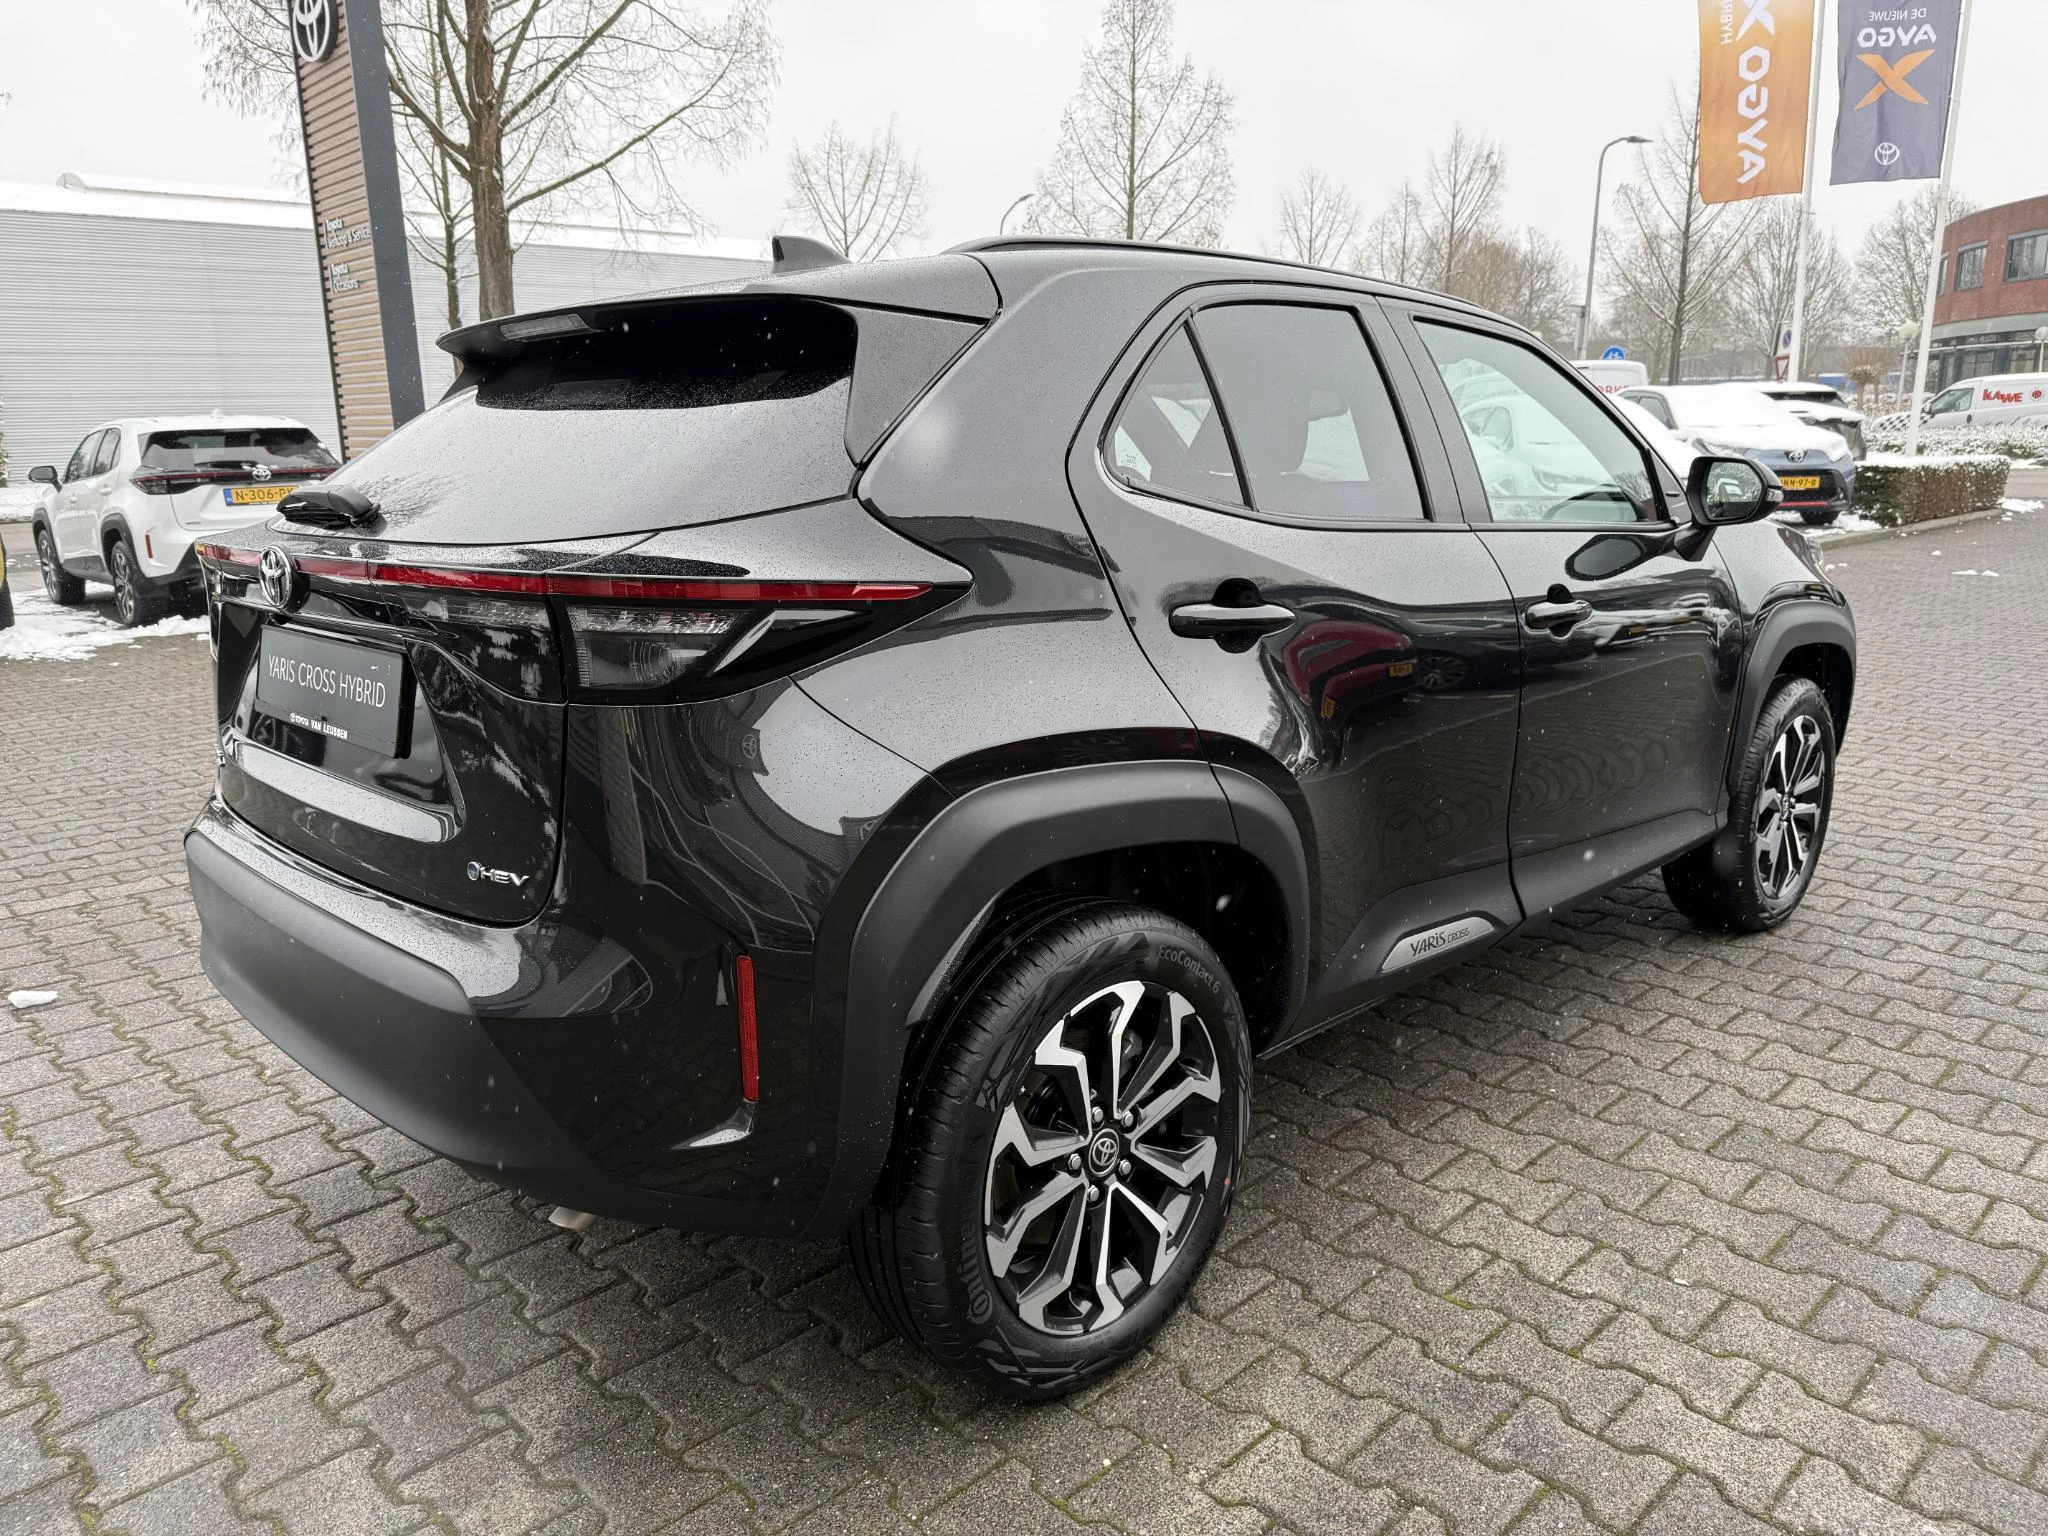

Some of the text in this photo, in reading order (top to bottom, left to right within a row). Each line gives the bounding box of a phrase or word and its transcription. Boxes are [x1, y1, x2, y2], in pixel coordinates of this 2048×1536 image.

[325, 218, 344, 233] Toyota
[331, 263, 349, 278] Toyota
[268, 654, 386, 708] YARIS CROSS HYBRID
[310, 719, 322, 731] VAN
[323, 723, 348, 740] LEUSSEN
[1159, 944, 1222, 995] EcoContact 6
